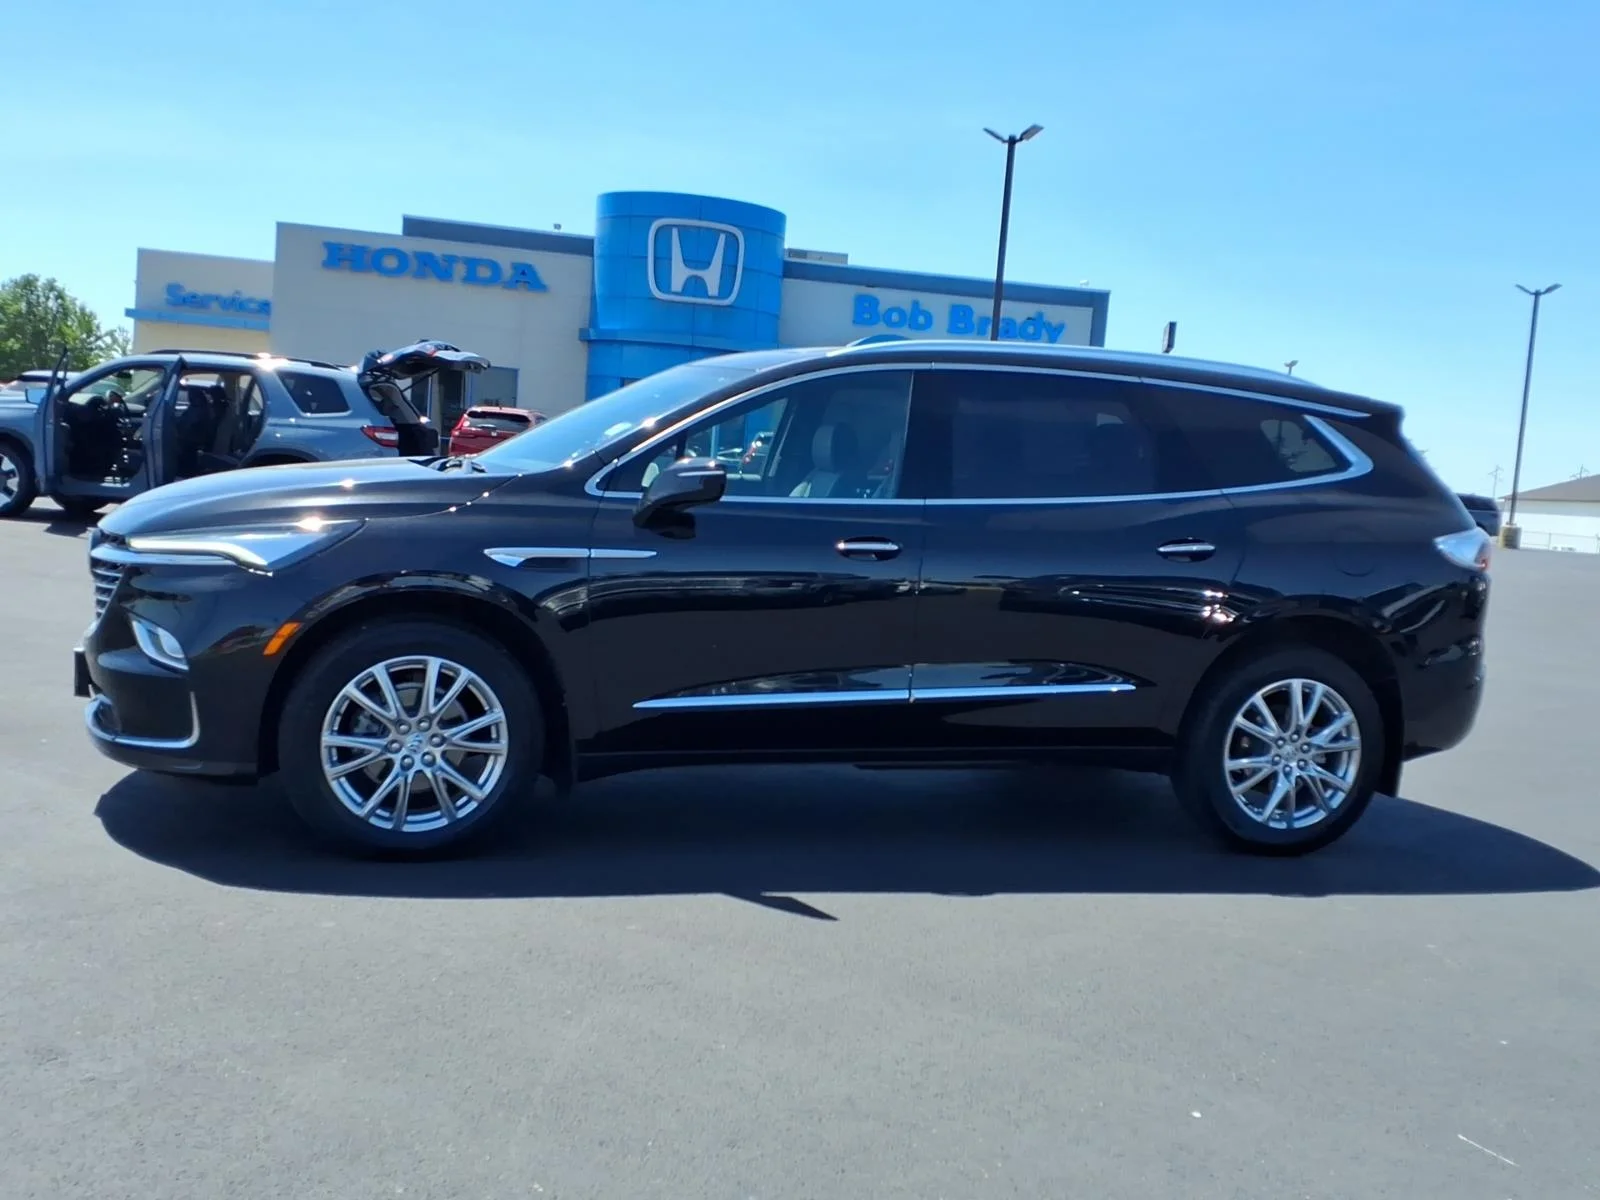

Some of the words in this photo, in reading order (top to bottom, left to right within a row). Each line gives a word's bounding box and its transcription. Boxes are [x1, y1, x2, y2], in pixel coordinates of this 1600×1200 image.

[321, 240, 549, 293] HONDA
[165, 282, 271, 315] Service
[853, 294, 933, 331] Bob
[947, 304, 1065, 344] Brady
